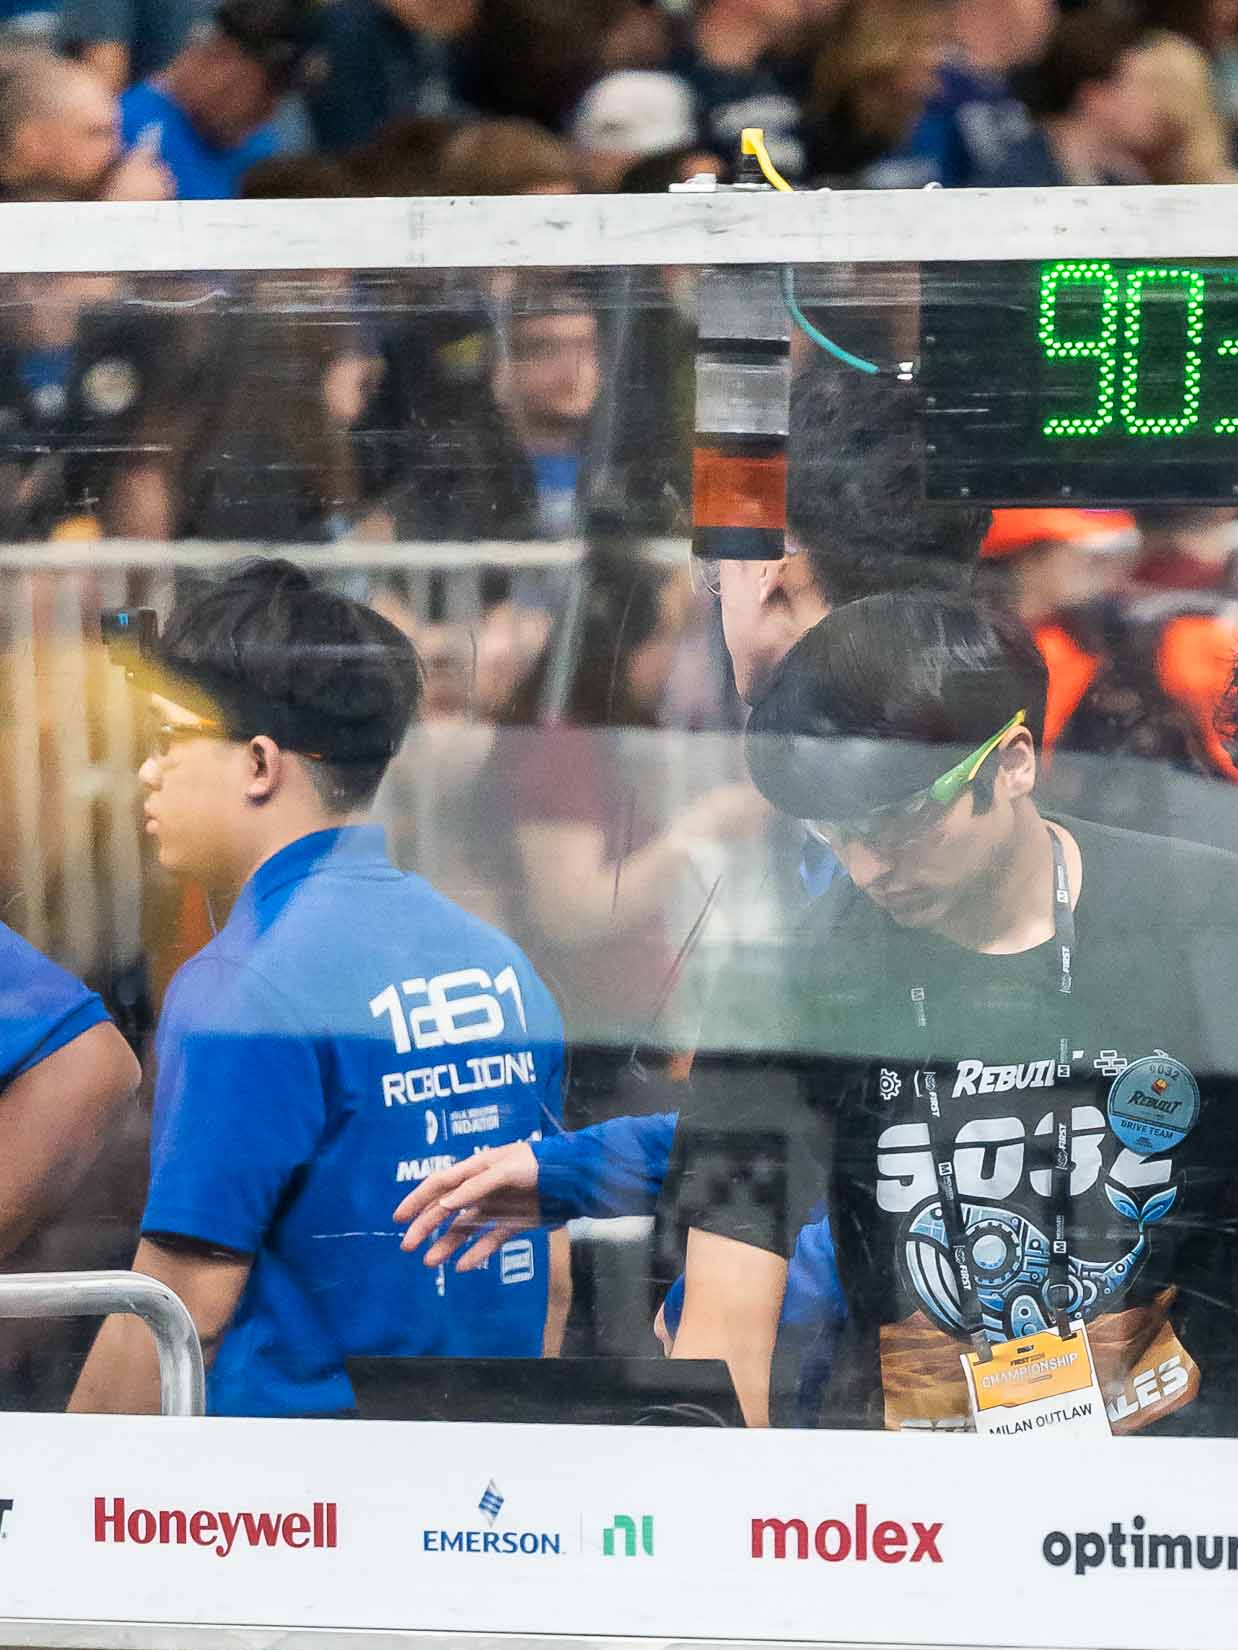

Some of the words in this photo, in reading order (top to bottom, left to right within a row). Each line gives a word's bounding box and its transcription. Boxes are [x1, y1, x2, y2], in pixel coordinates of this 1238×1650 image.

[929, 1092, 941, 1118] FIRST
[1127, 1090, 1183, 1114] REBUILT
[1058, 1123, 1067, 1151] FIRST
[1120, 1119, 1147, 1133] DRIVE
[1148, 1125, 1174, 1139] TEAM
[959, 1264, 971, 1291] FIRST
[982, 1352, 1079, 1388] CHAMPIONSHIP
[989, 1418, 1034, 1435] MILAN
[1035, 1402, 1092, 1428] OUTLAW
[94, 1496, 338, 1558] Honeywell
[752, 1504, 944, 1564] molex
[423, 1530, 561, 1555] EMERSON
